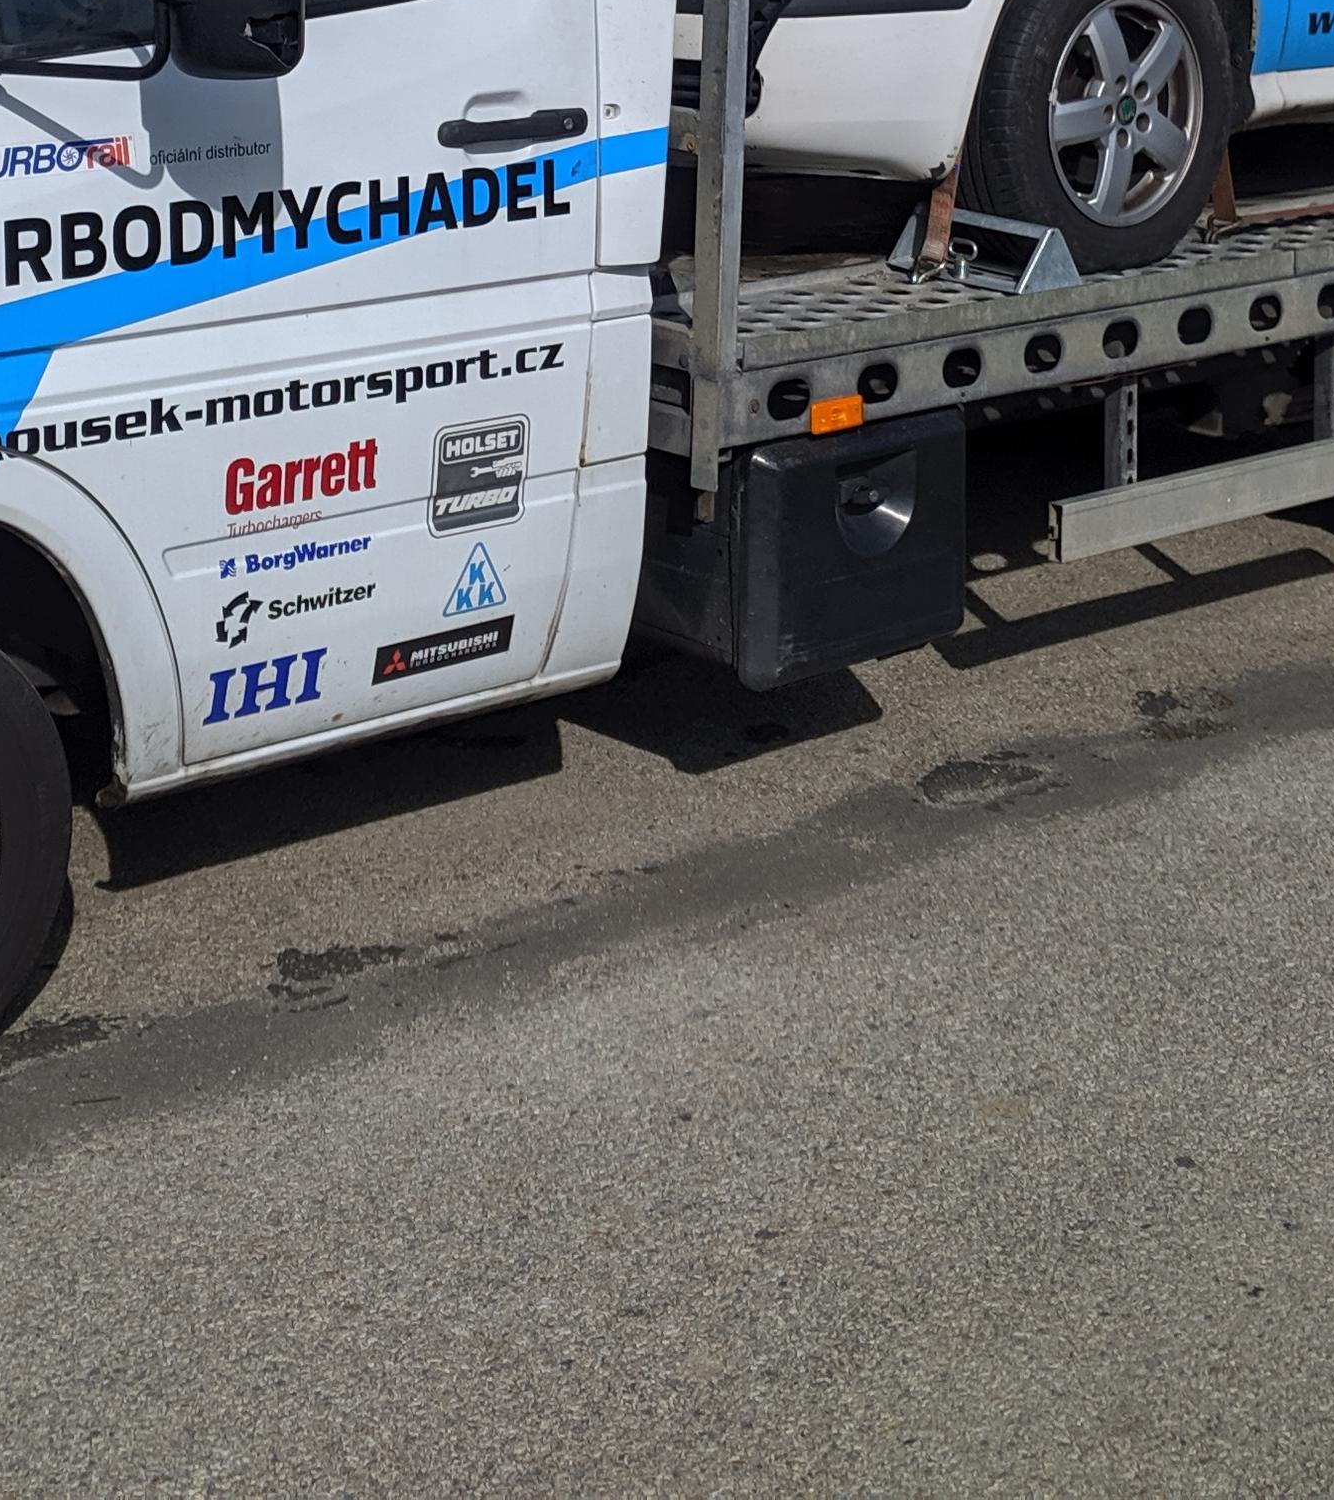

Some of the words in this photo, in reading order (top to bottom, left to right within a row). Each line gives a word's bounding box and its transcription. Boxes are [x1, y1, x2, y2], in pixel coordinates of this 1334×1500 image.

[206, 141, 271, 161] distributor
[446, 429, 519, 458] HOLSET
[225, 438, 378, 515] Garrett
[435, 485, 518, 516] TURBO
[227, 510, 323, 538] Turbochargers
[244, 536, 372, 574] BorgWarner
[267, 583, 376, 620] Schwitzer
[410, 631, 499, 663] MITSUBISHI
[202, 647, 328, 726] IHI
